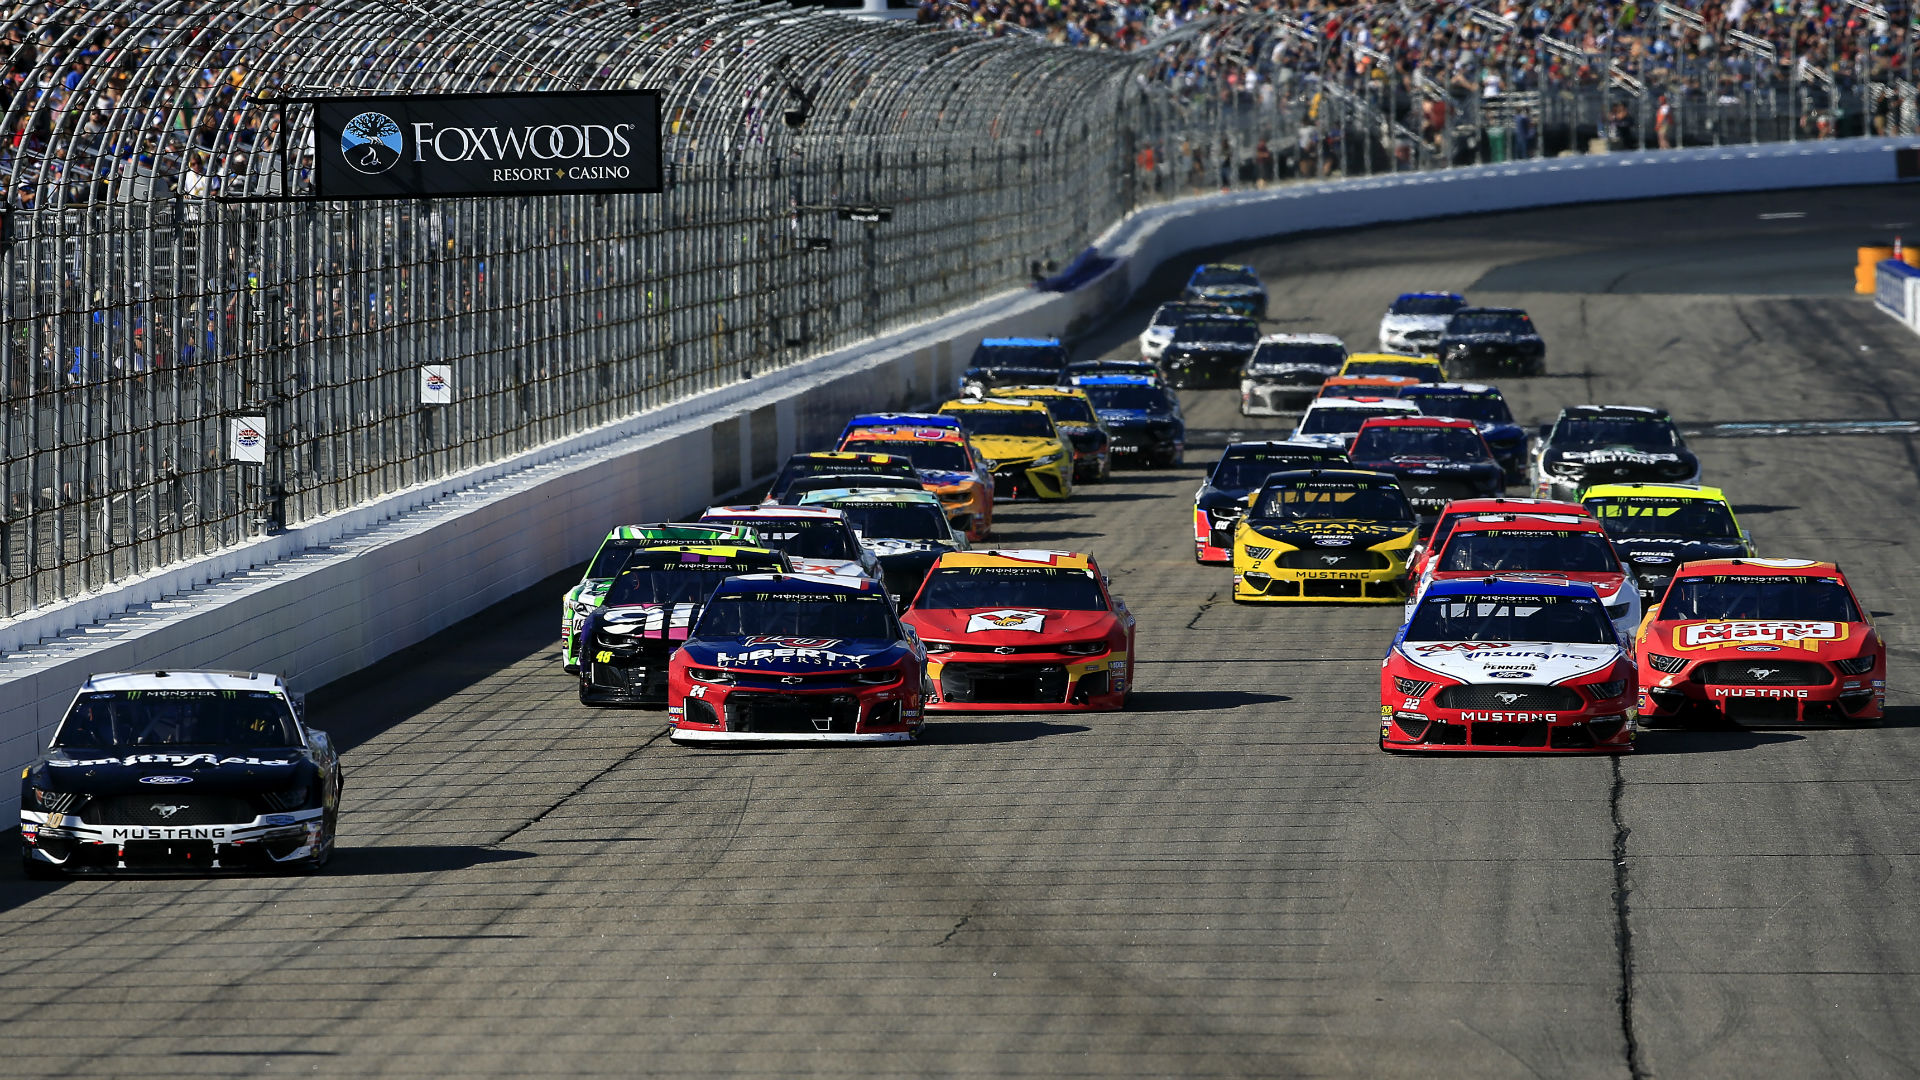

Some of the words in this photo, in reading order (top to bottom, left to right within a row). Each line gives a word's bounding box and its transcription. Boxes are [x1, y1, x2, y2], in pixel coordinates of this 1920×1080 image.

[411, 122, 631, 162] FOXWOODS
[493, 167, 551, 182] RESORT
[568, 166, 630, 180] CASINO
[1296, 571, 1370, 579] MUSTANG
[1697, 628, 1829, 641] Mayer
[595, 650, 613, 664] 48
[717, 648, 871, 662] LIBERTY
[718, 656, 868, 669] UNIVERSITY
[1658, 675, 1675, 687] 6
[689, 684, 708, 698] 24
[1715, 688, 1809, 698] MUSTANG
[1402, 697, 1421, 711] 22
[1461, 711, 1557, 723] MUSTANG
[43, 812, 64, 829] 10
[112, 828, 226, 840] MUSTANG
